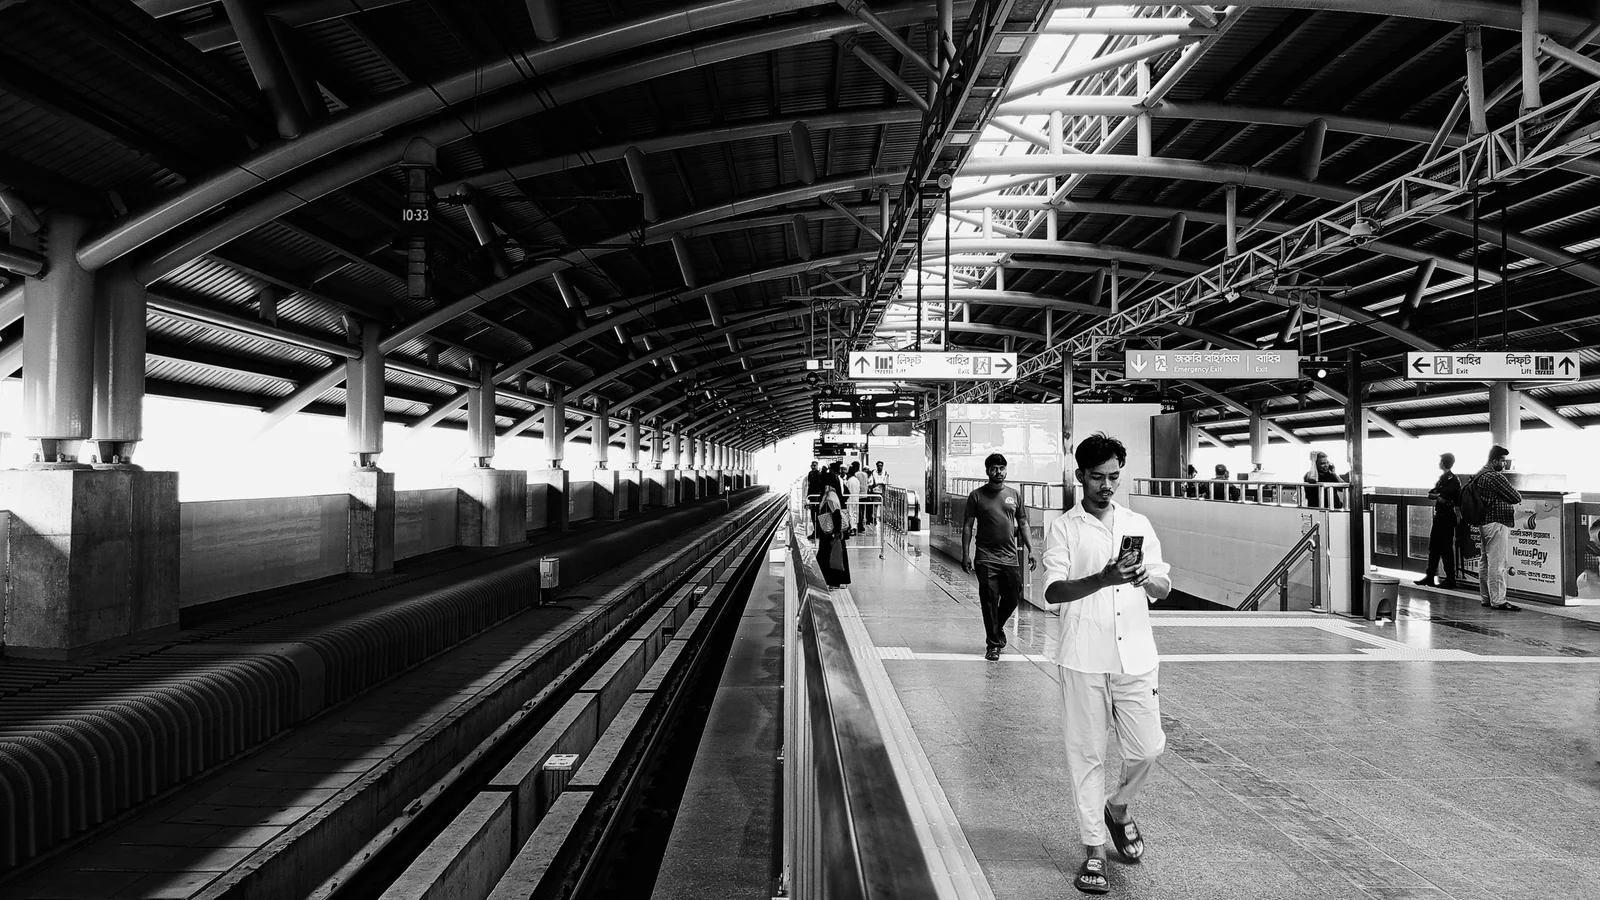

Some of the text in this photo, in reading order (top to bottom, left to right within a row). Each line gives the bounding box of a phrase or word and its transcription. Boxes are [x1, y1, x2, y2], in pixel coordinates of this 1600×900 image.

[945, 354, 970, 366] বাহির
[1174, 352, 1240, 364] জরুরি বহির্গমন
[1255, 352, 1281, 364] বাহির
[1456, 354, 1482, 366] বাহির
[1506, 354, 1532, 368] লিফ্ট
[1174, 366, 1209, 374] Emergency
[1512, 546, 1548, 563] NexusPay
